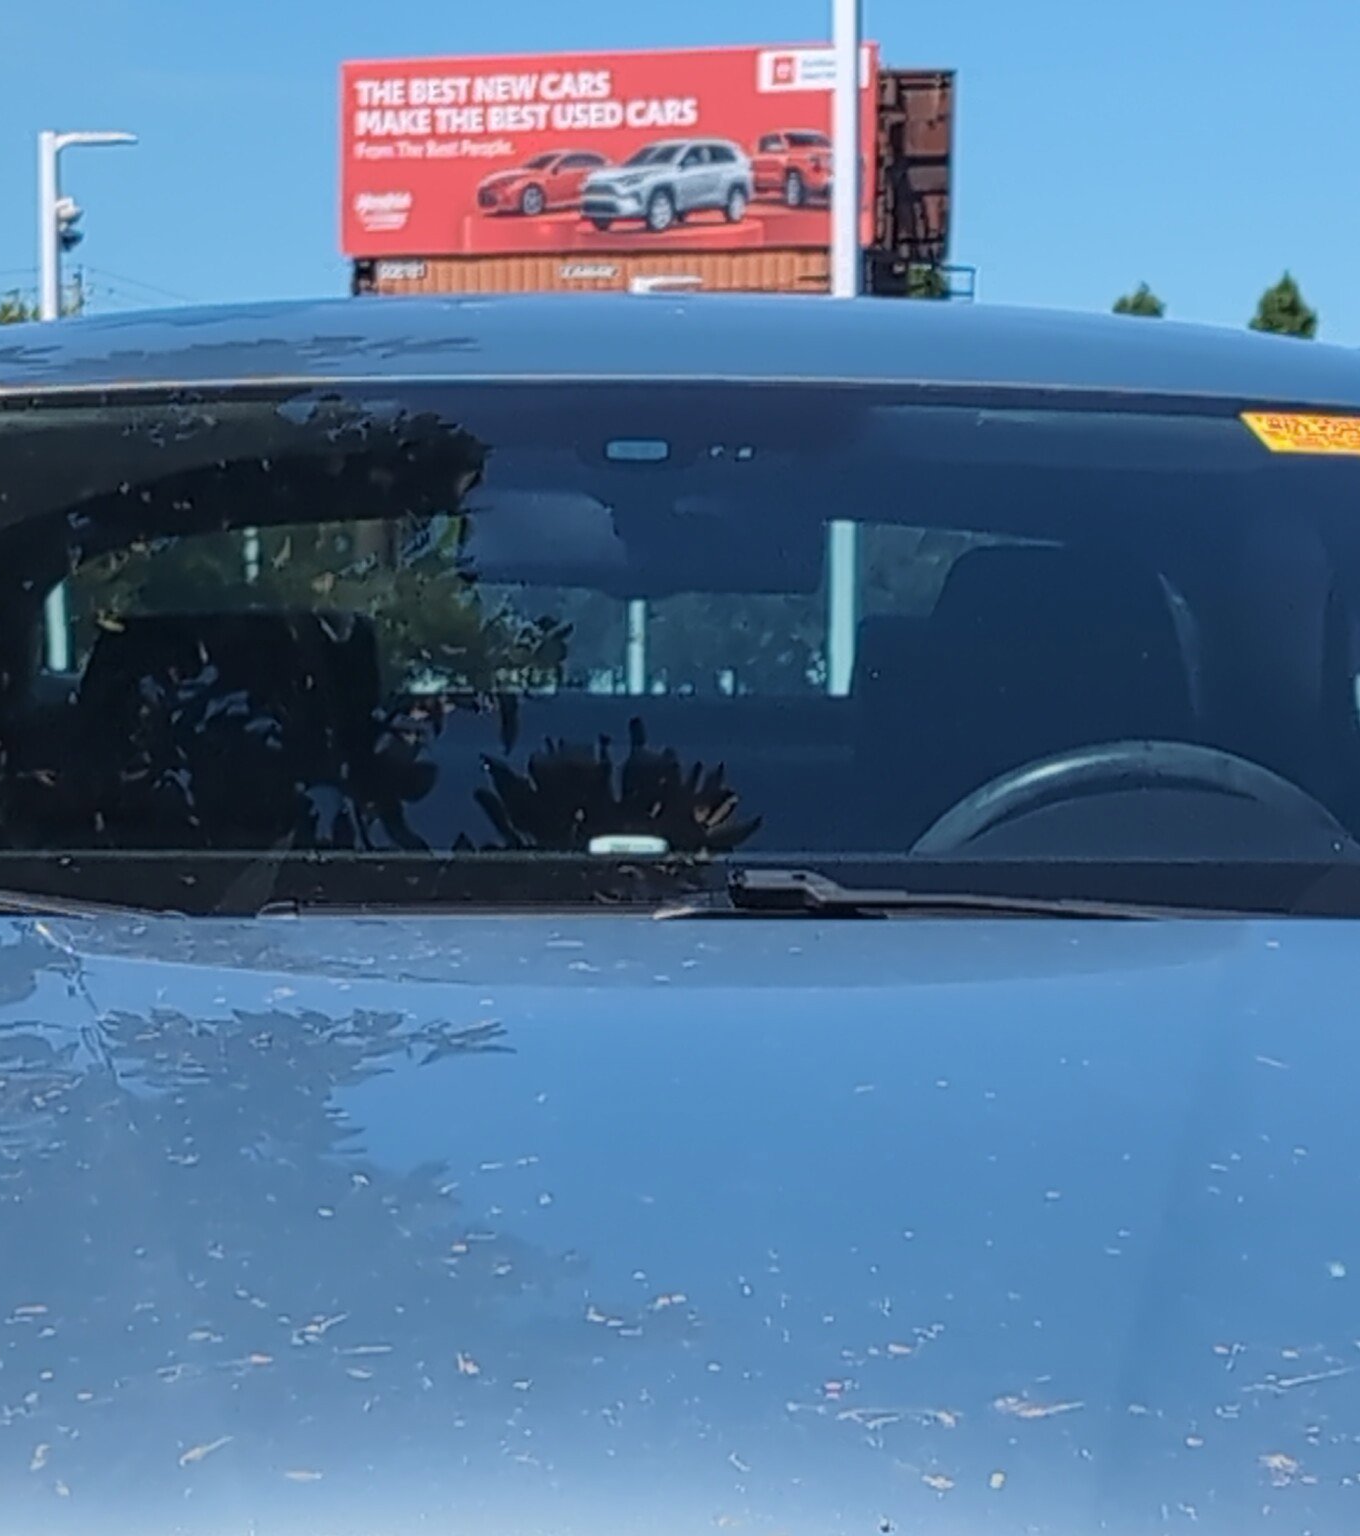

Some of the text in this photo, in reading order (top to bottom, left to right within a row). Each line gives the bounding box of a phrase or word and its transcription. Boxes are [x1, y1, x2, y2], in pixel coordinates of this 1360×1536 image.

[355, 71, 611, 106] THE BEST NEW CARS
[354, 97, 698, 136] MAKE THE BEST USED CARS
[354, 141, 394, 159] From
[396, 140, 424, 158] The
[425, 139, 459, 158] Best
